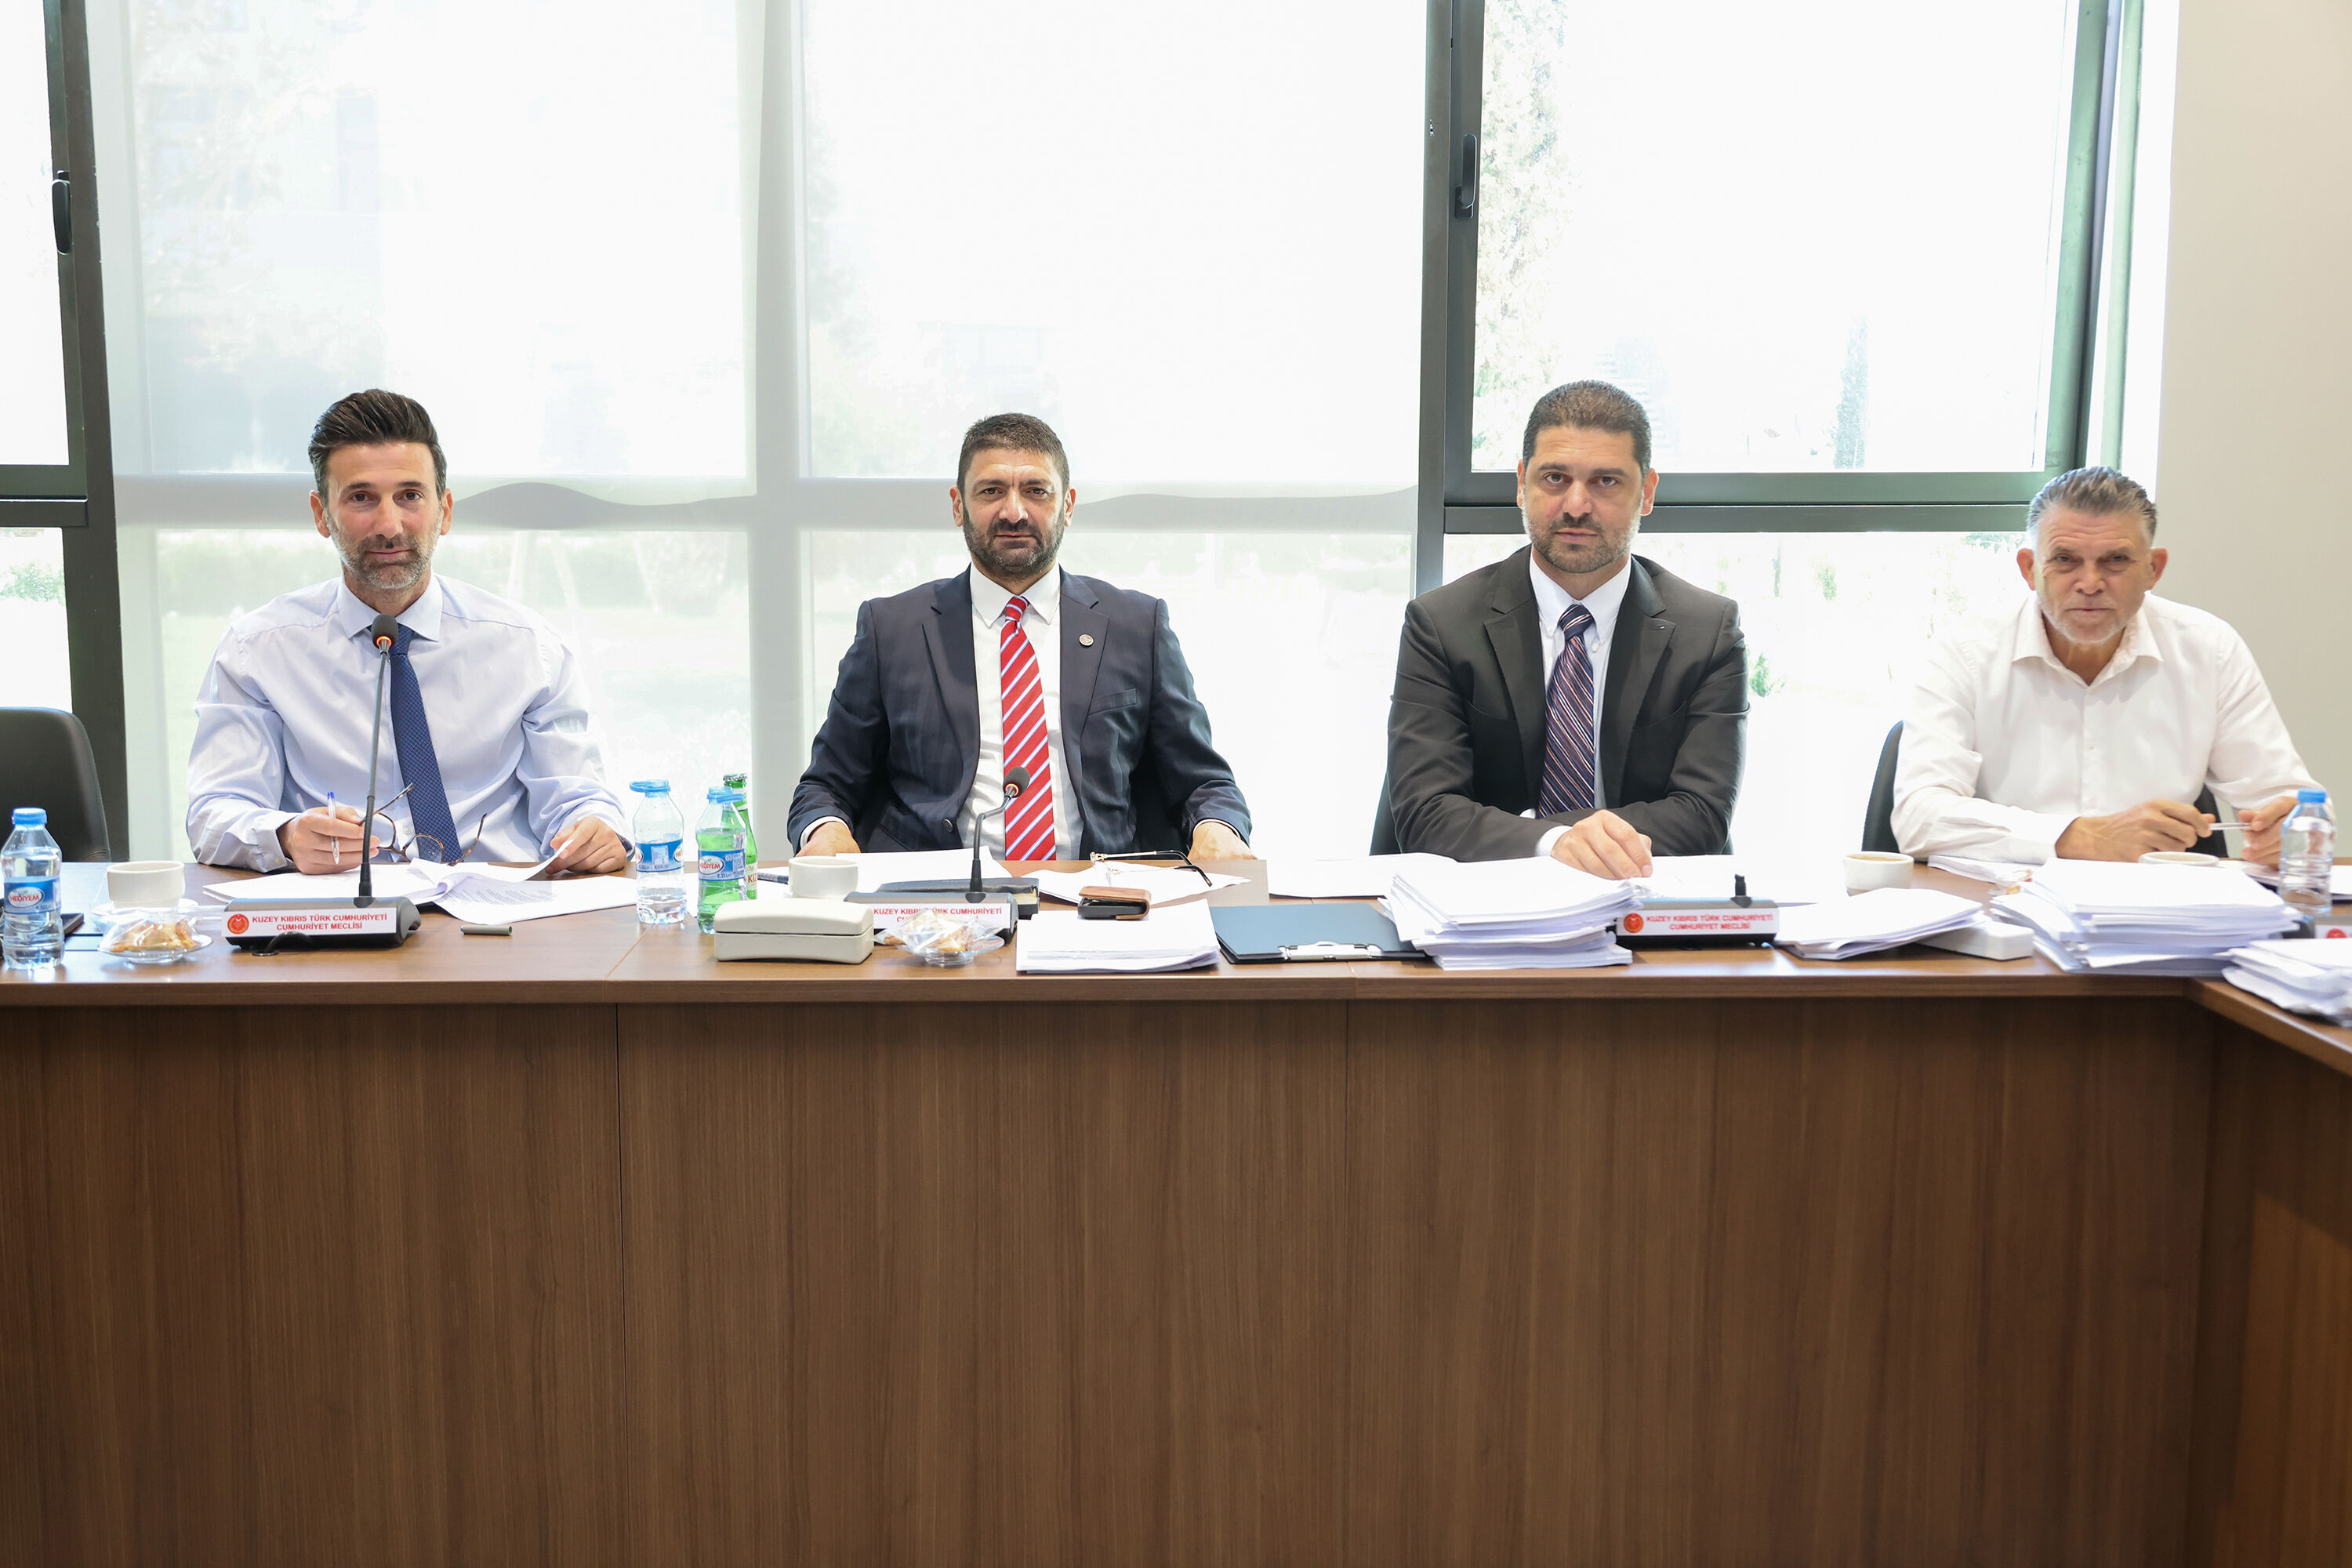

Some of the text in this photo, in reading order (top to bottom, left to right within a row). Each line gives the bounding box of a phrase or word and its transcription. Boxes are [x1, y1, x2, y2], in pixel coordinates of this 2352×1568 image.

[950, 906, 1002, 915] CUMHURİYETİ
[309, 913, 332, 922] TÜRK
[332, 913, 387, 921] CUMHURİYETİ
[277, 922, 328, 931] CUMHURİYET
